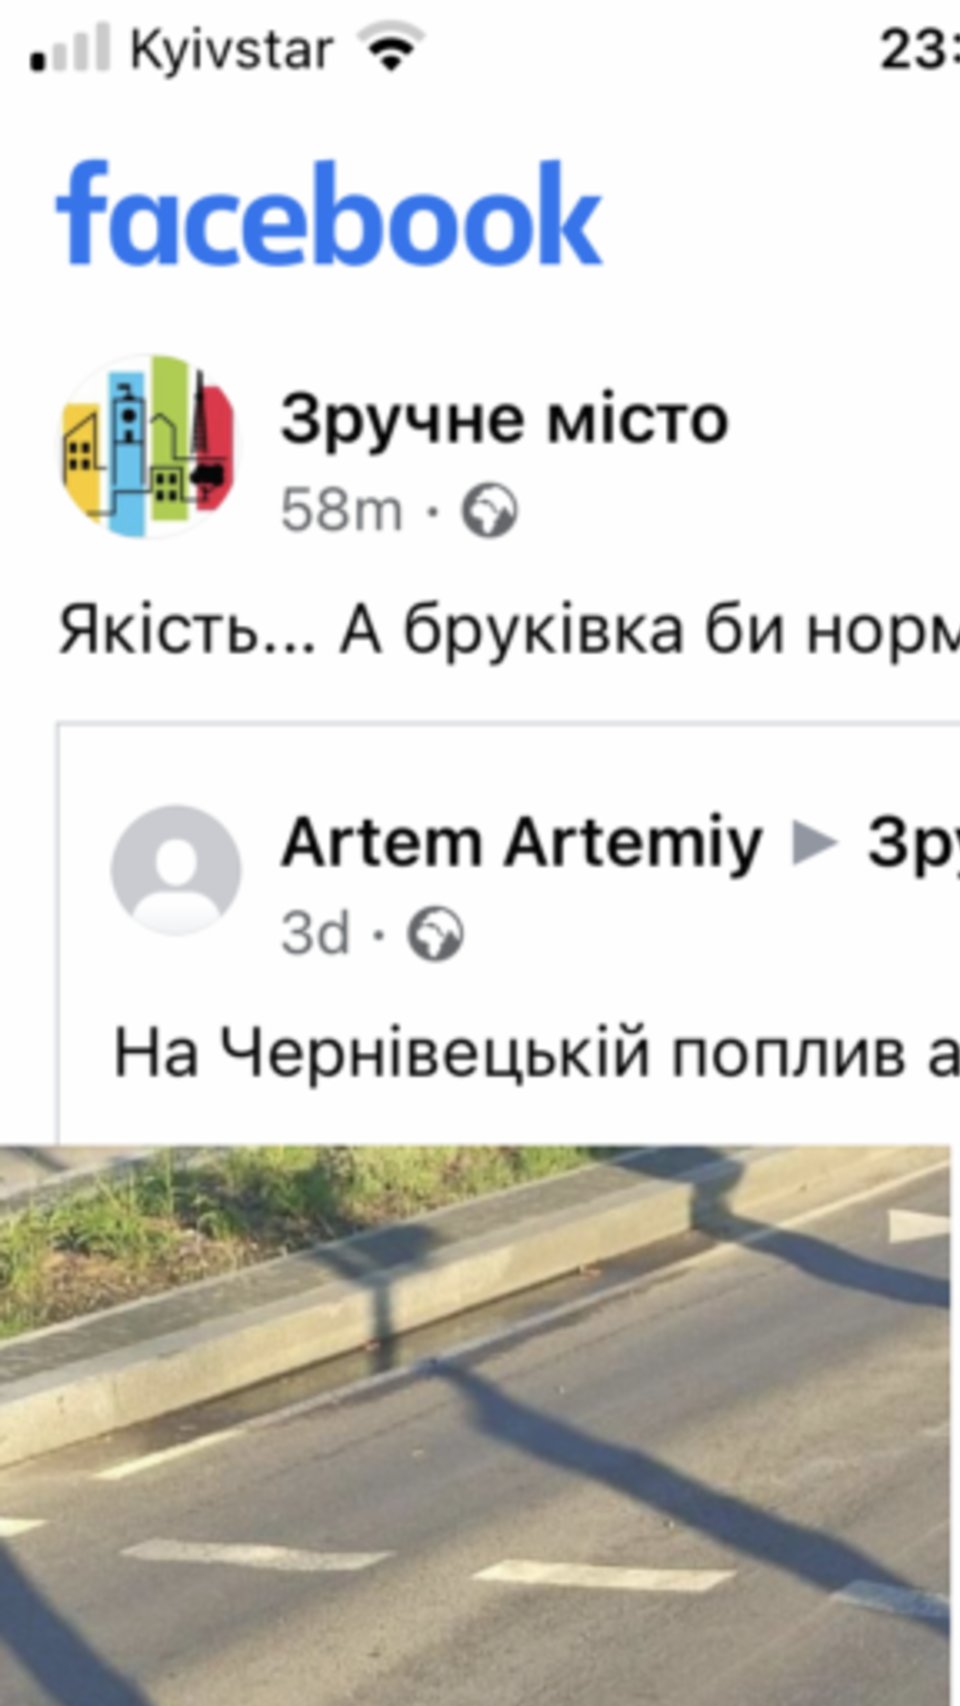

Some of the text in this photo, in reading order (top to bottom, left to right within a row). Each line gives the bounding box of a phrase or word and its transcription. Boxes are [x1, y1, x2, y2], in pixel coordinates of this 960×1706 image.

[131, 26, 334, 80] Kyivstar
[55, 158, 603, 267] facebook
[281, 388, 729, 458] Зручне місто
[282, 486, 402, 532] 58m
[60, 600, 316, 654] Якість...
[339, 602, 382, 654] А
[404, 600, 684, 667] бруківка
[706, 600, 783, 654] би
[280, 811, 764, 880] Artem Artemiy
[282, 909, 349, 955] 3d
[115, 1026, 198, 1078] На
[221, 1022, 648, 1089] Чернівецькій
[673, 1037, 905, 1078] поплив
